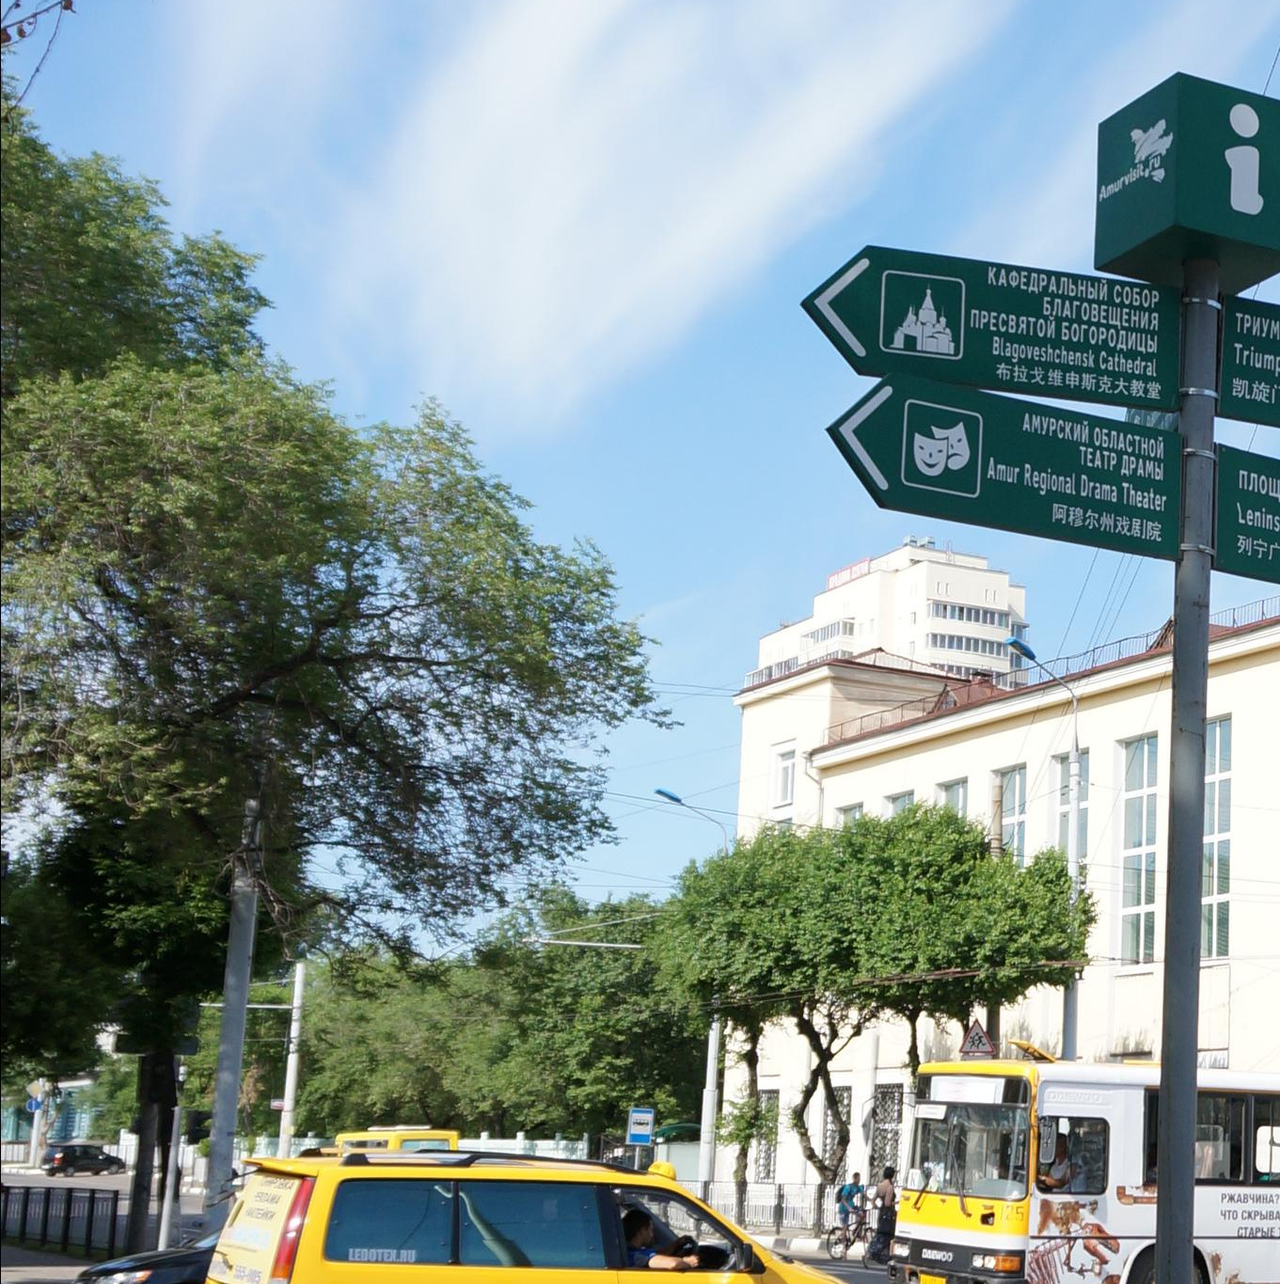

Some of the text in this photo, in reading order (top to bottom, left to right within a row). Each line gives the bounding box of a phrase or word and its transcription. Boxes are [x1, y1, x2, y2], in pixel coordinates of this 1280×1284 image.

[988, 267, 1160, 308] КАФЕДРАЛЬНЫЙ СОБОР
[970, 309, 1157, 354] ПРЕСВЯТОЙ БОГОРОДИЦЫ
[1043, 298, 1159, 331] БЛАГОВЕЩЕНИЯ
[992, 336, 1157, 377] Blagoveshchensk Cathedral
[995, 362, 1162, 400] 布拉戈维申斯克大教堂
[1022, 412, 1164, 459] АМУРСКИЙ ОБЛАСТНОЙ
[1079, 446, 1164, 481] ТЕАТР ДРАМЫ
[987, 457, 1167, 512] Amur Regional Drama Theater
[1052, 503, 1163, 542] 阿穆尔州戏剧院
[1237, 503, 1280, 533] Lenins
[1220, 1193, 1280, 1204] РЖАВЧИНА?
[1220, 1210, 1239, 1221] ЧТО
[1237, 1226, 1275, 1237] СТАРЫЕ
[921, 1248, 953, 1263] DAEWOO
